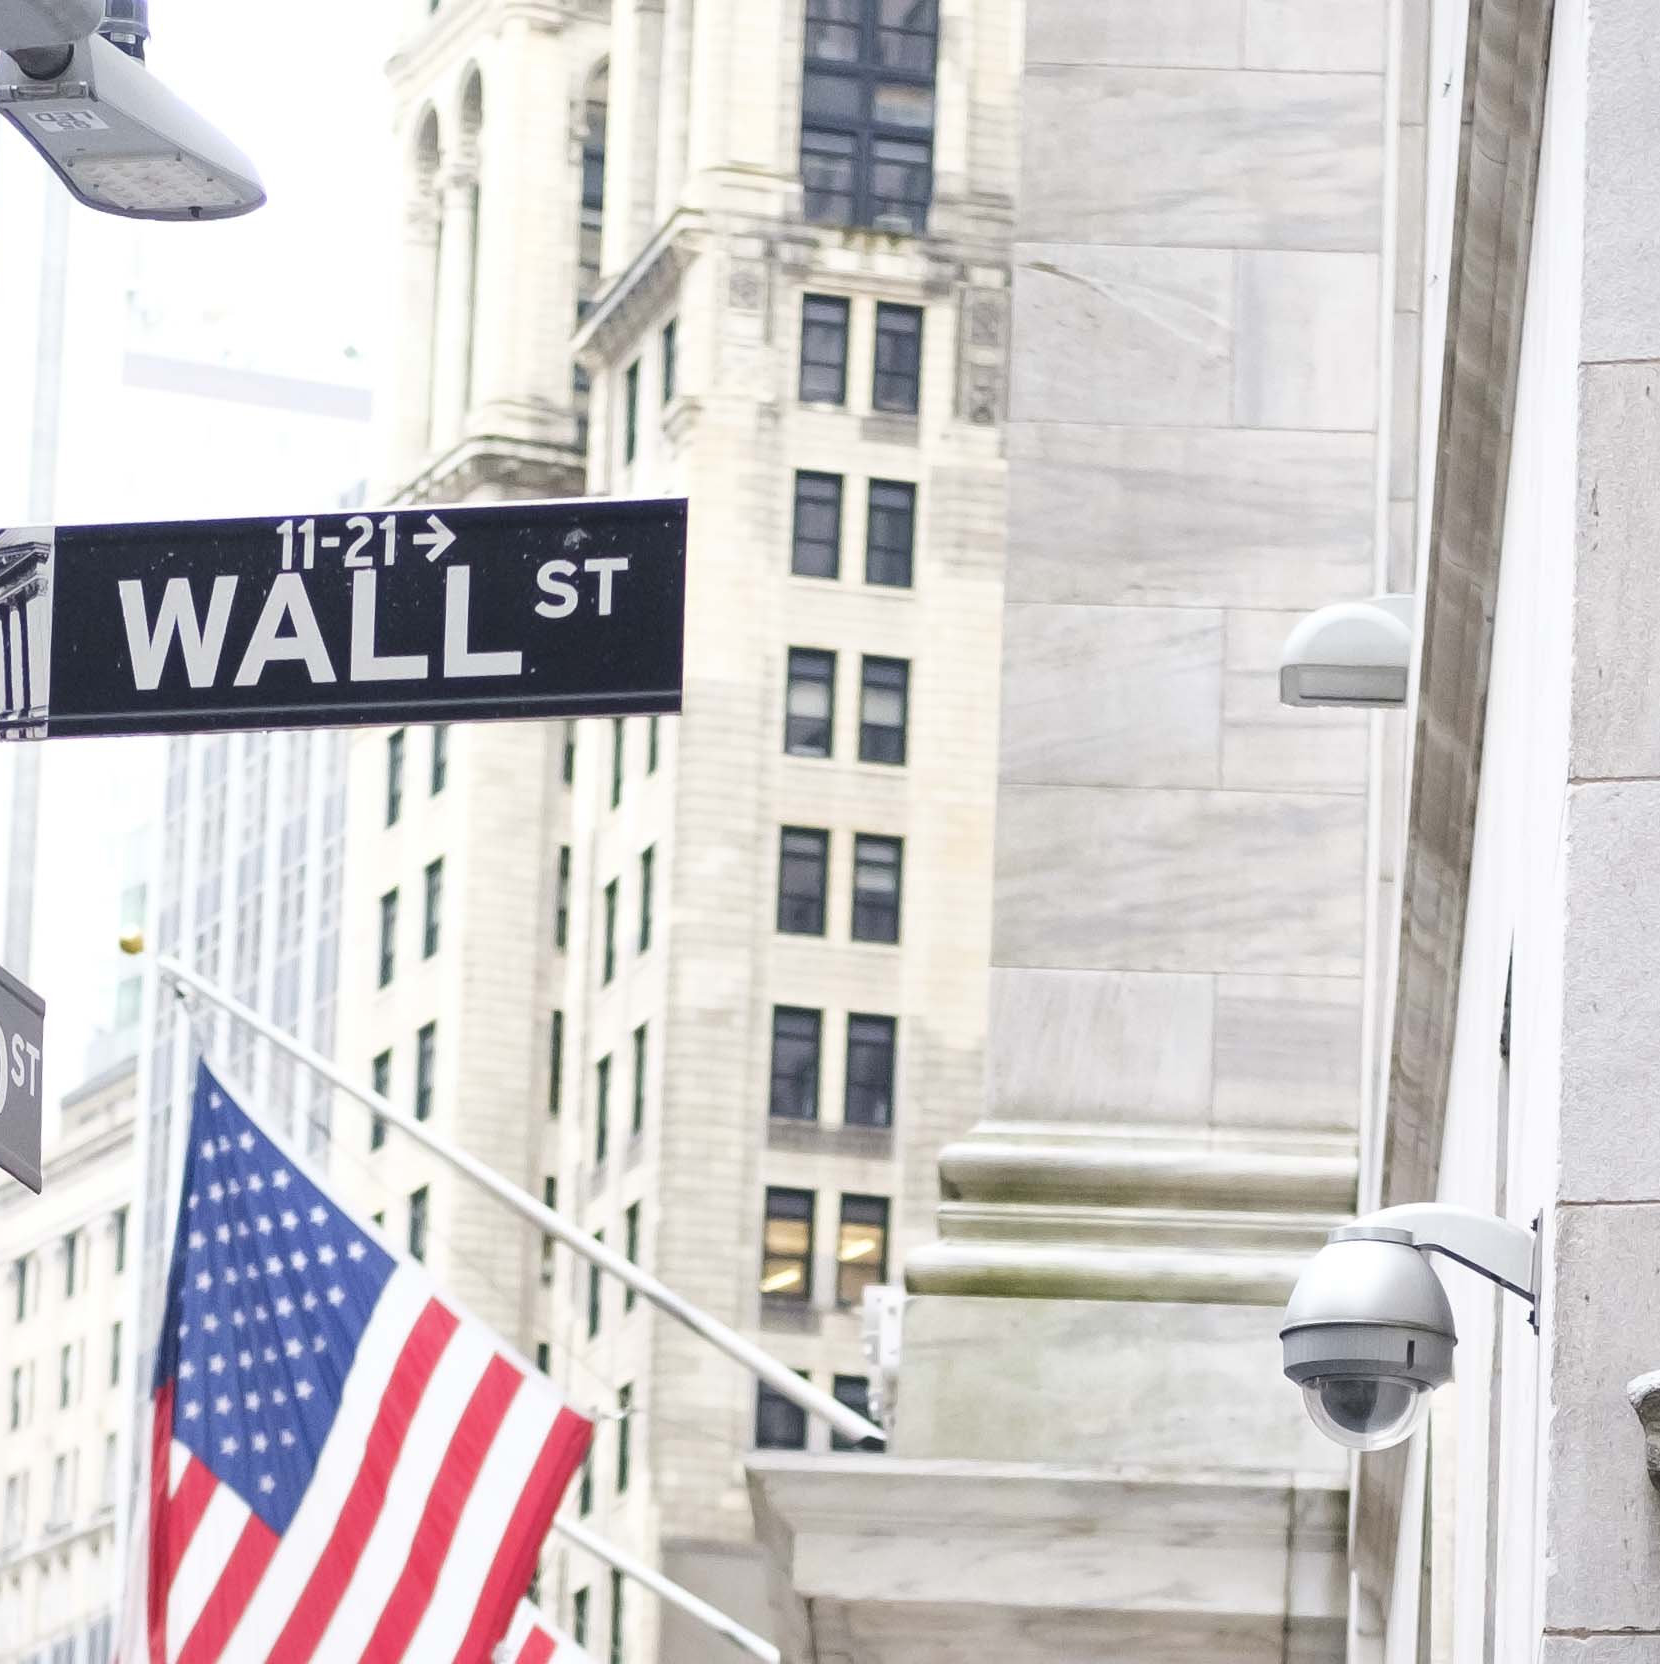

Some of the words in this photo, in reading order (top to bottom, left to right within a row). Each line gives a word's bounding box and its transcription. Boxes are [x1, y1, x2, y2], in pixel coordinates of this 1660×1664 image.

[34, 111, 94, 121] LED
[276, 514, 397, 571] 11-21
[118, 565, 523, 690] WALL
[534, 557, 629, 619] ST
[10, 1032, 40, 1097] ST
